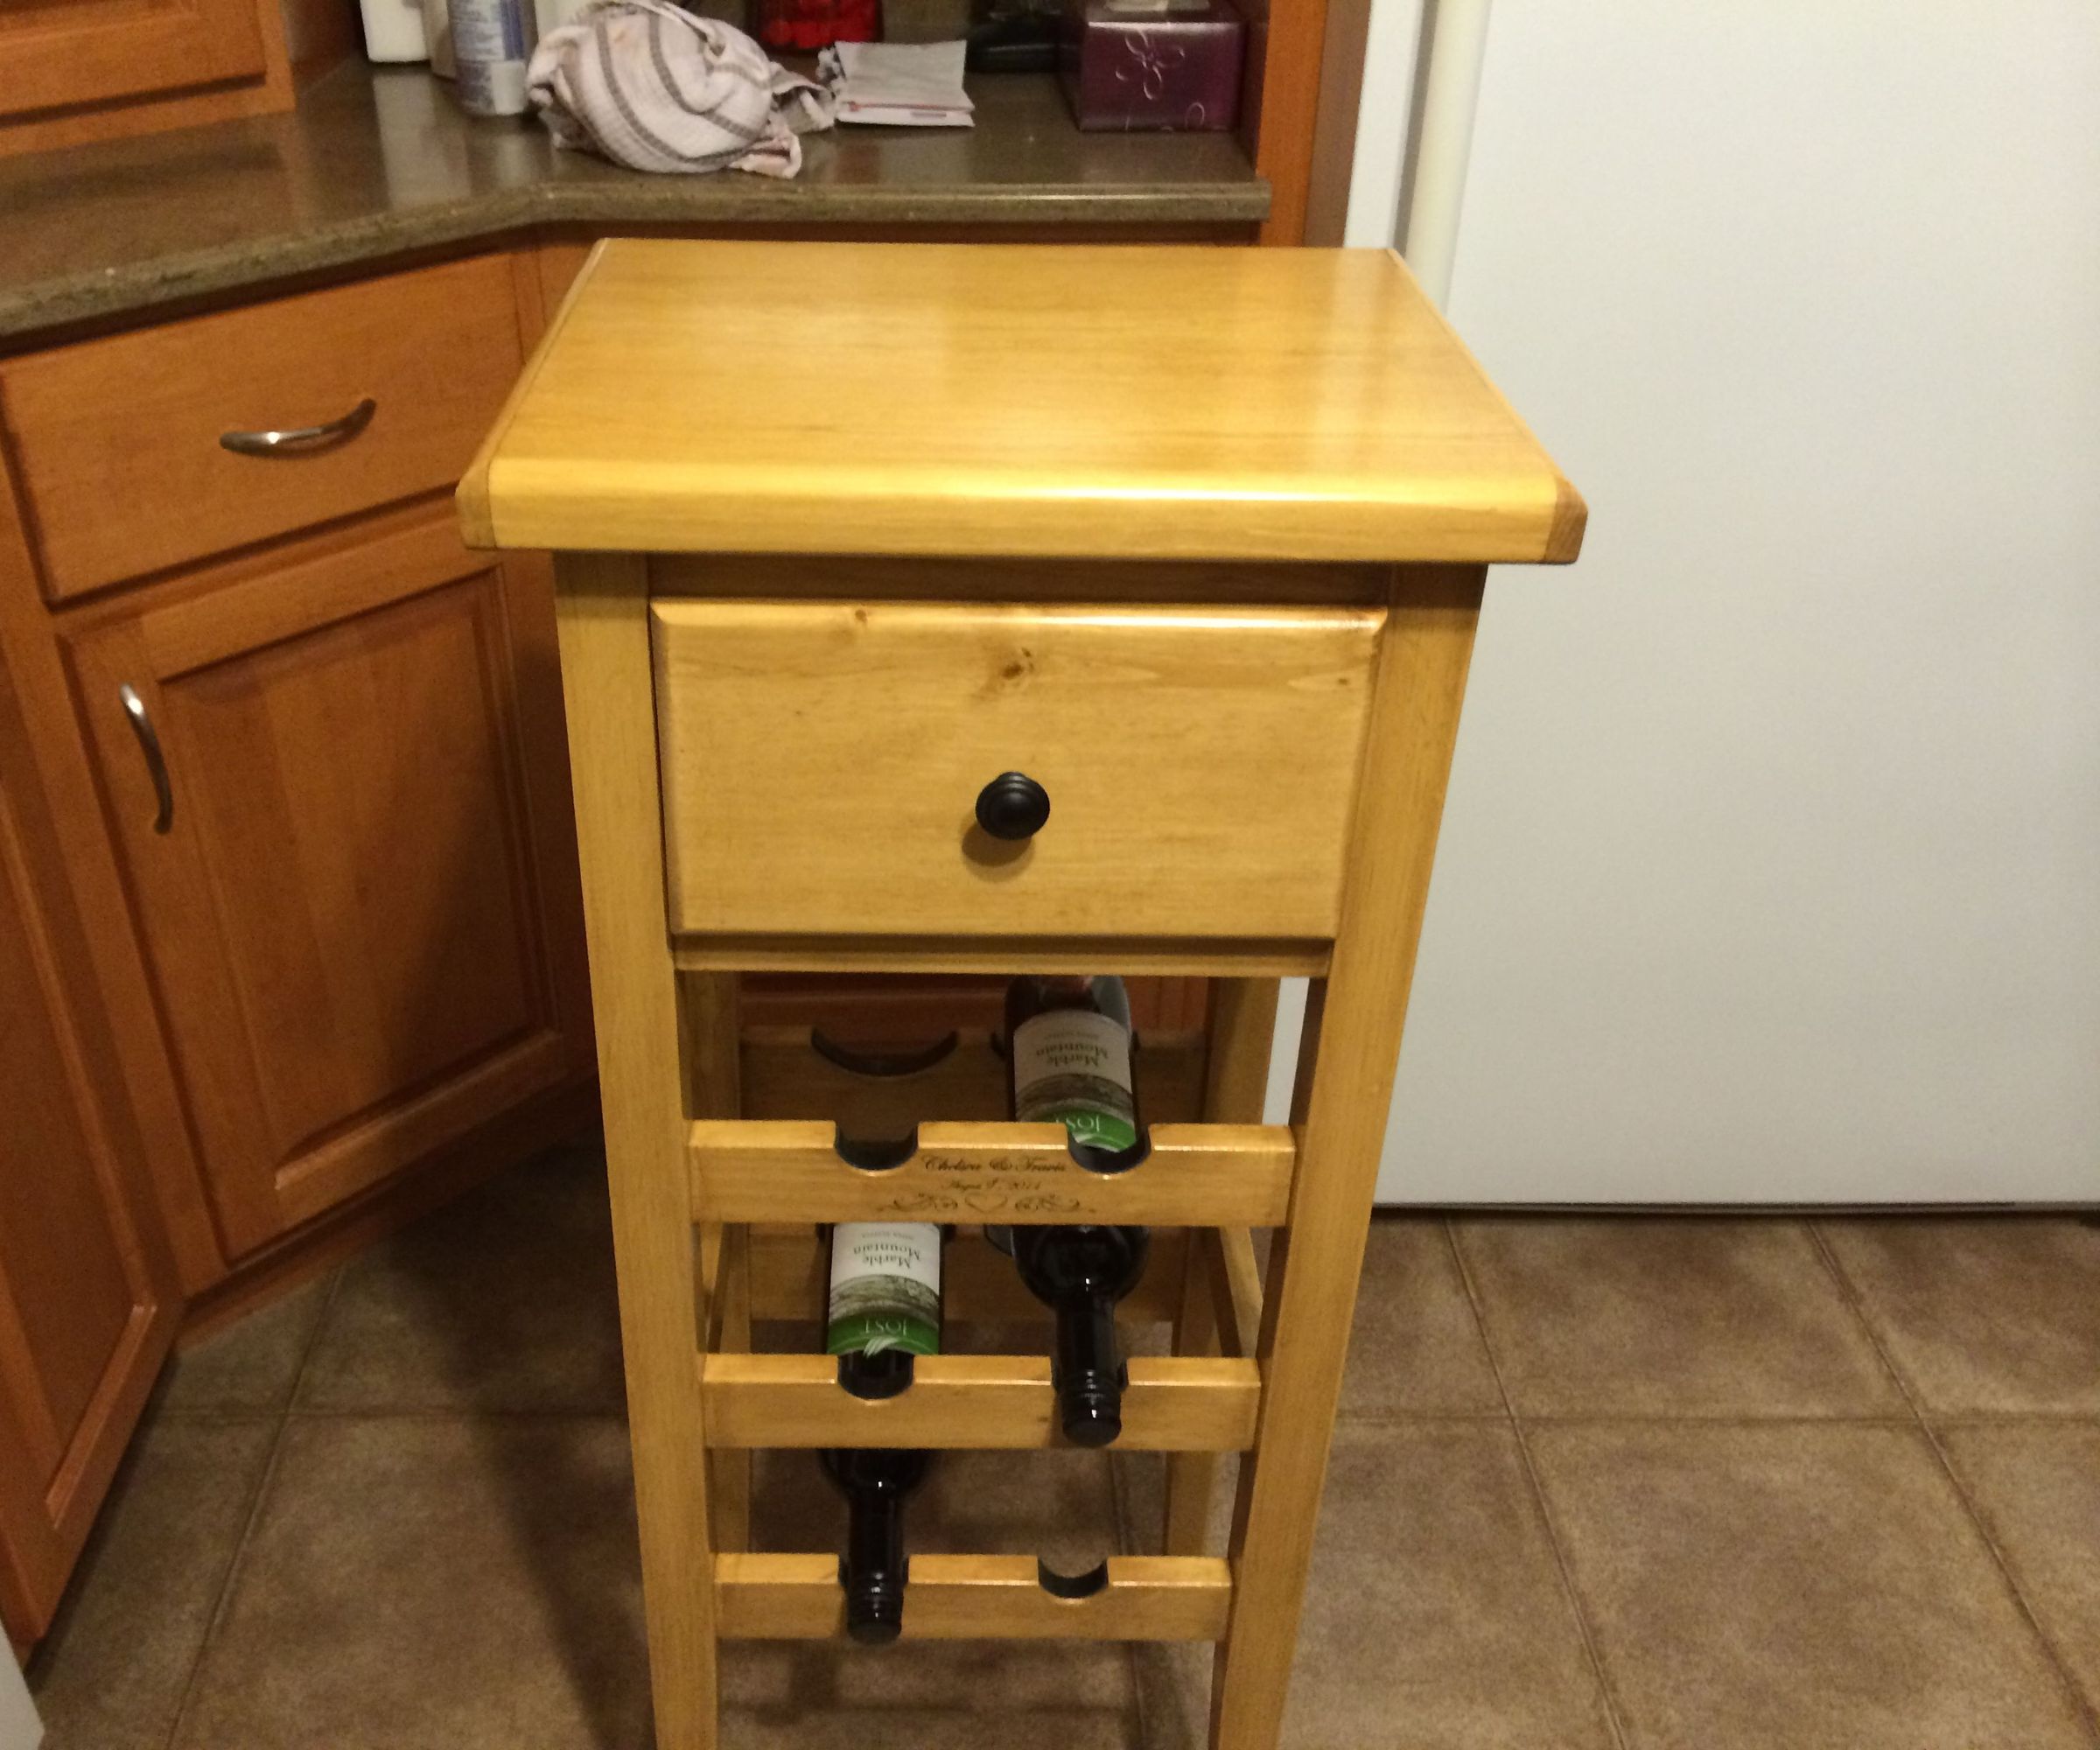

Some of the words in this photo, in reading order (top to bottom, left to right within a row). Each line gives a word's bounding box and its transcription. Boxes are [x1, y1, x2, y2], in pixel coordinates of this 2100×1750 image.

[1036, 1044, 1109, 1060] Mountain
[1046, 1054, 1099, 1068] Marble
[853, 1243, 921, 1262] Mountain
[863, 1255, 911, 1270] Marble
[864, 1316, 907, 1337] JOST
